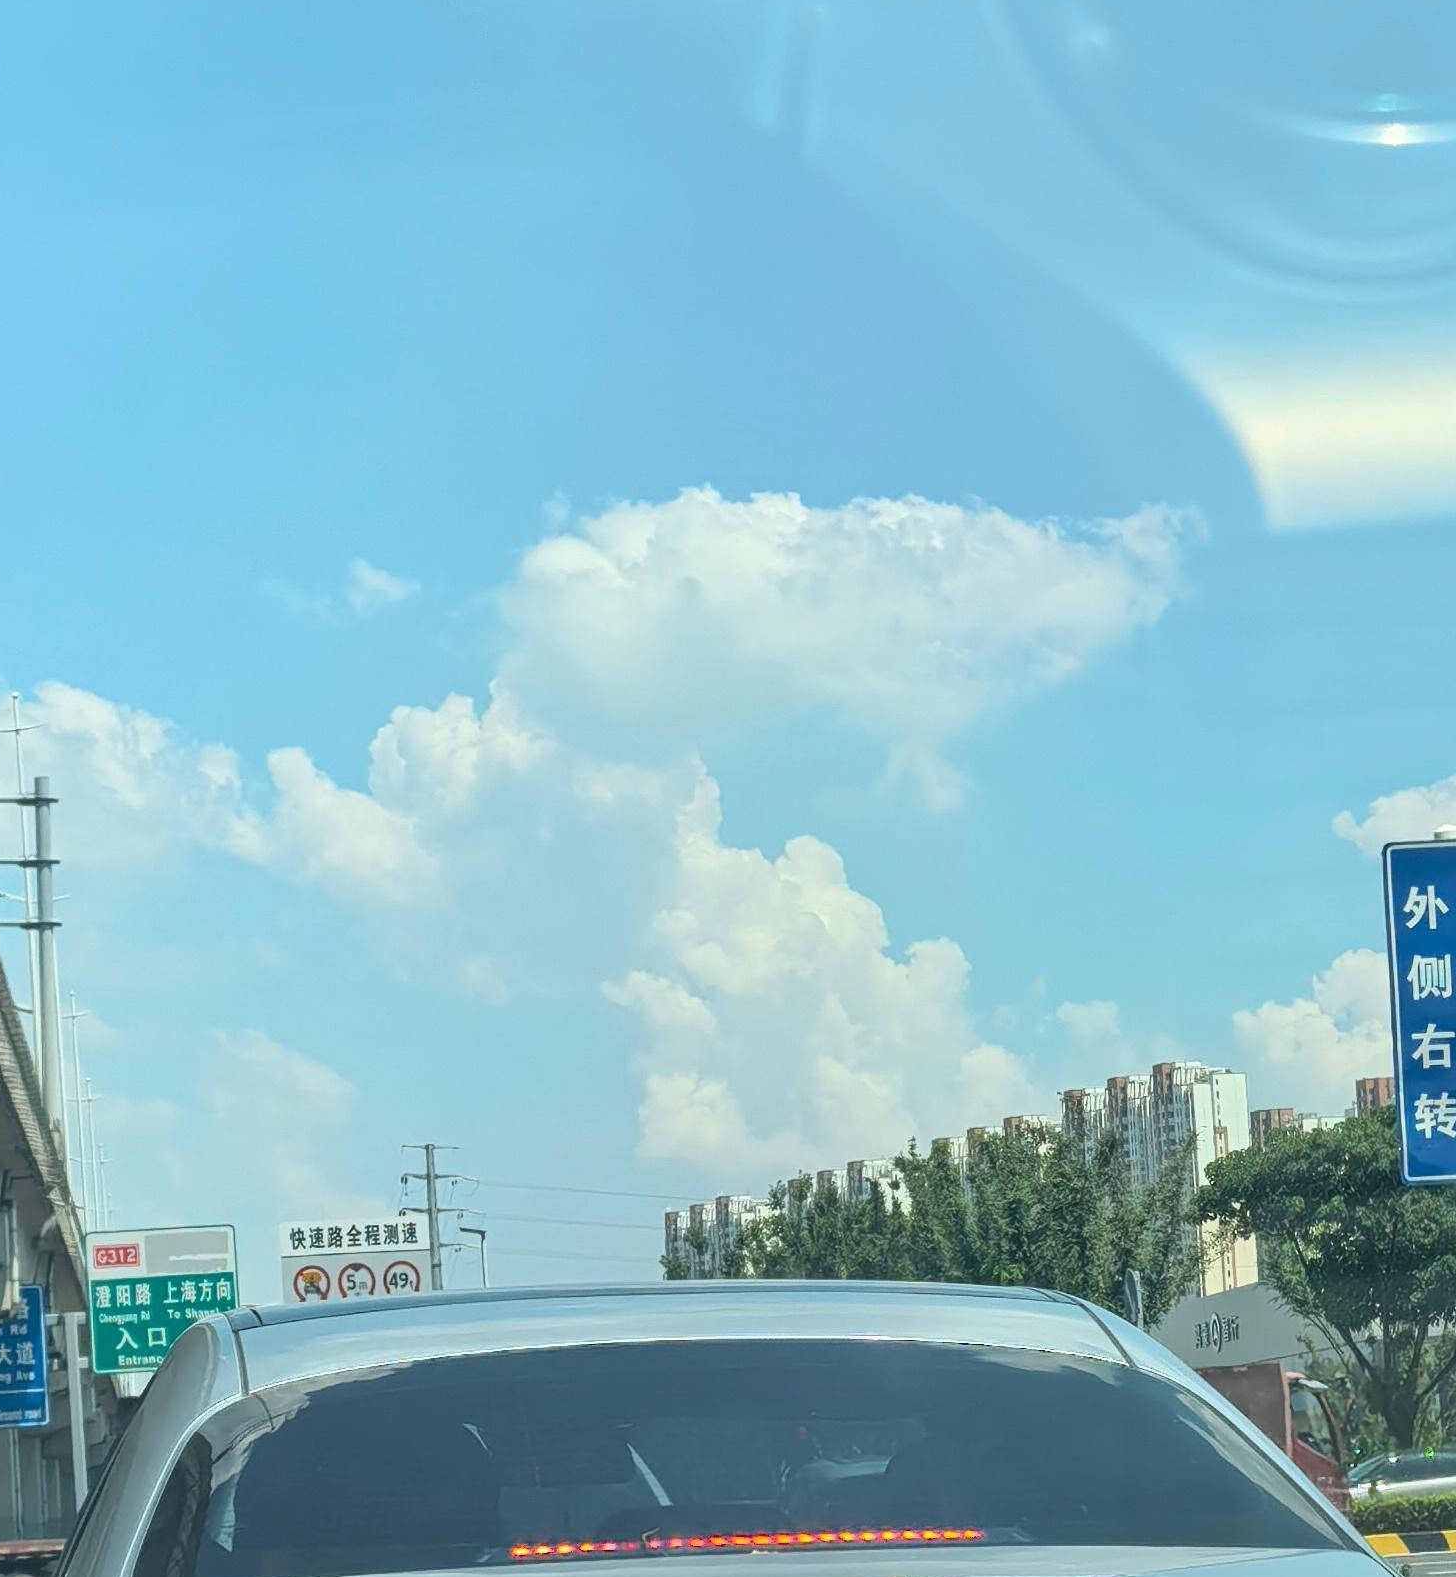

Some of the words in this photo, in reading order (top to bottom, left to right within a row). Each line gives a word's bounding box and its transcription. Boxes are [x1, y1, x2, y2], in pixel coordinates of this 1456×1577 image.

[289, 1222, 419, 1251] 快速路全程测速
[97, 1248, 137, 1265] G312
[95, 1283, 152, 1308] 澄阳路
[163, 1278, 232, 1304] 上海方向
[141, 1310, 151, 1322] Rd
[167, 1309, 181, 1319] To
[10, 1325, 29, 1336] Rd
[115, 1327, 167, 1350] 入口
[117, 1355, 165, 1366] Entranc
[15, 1371, 36, 1382] Ave
